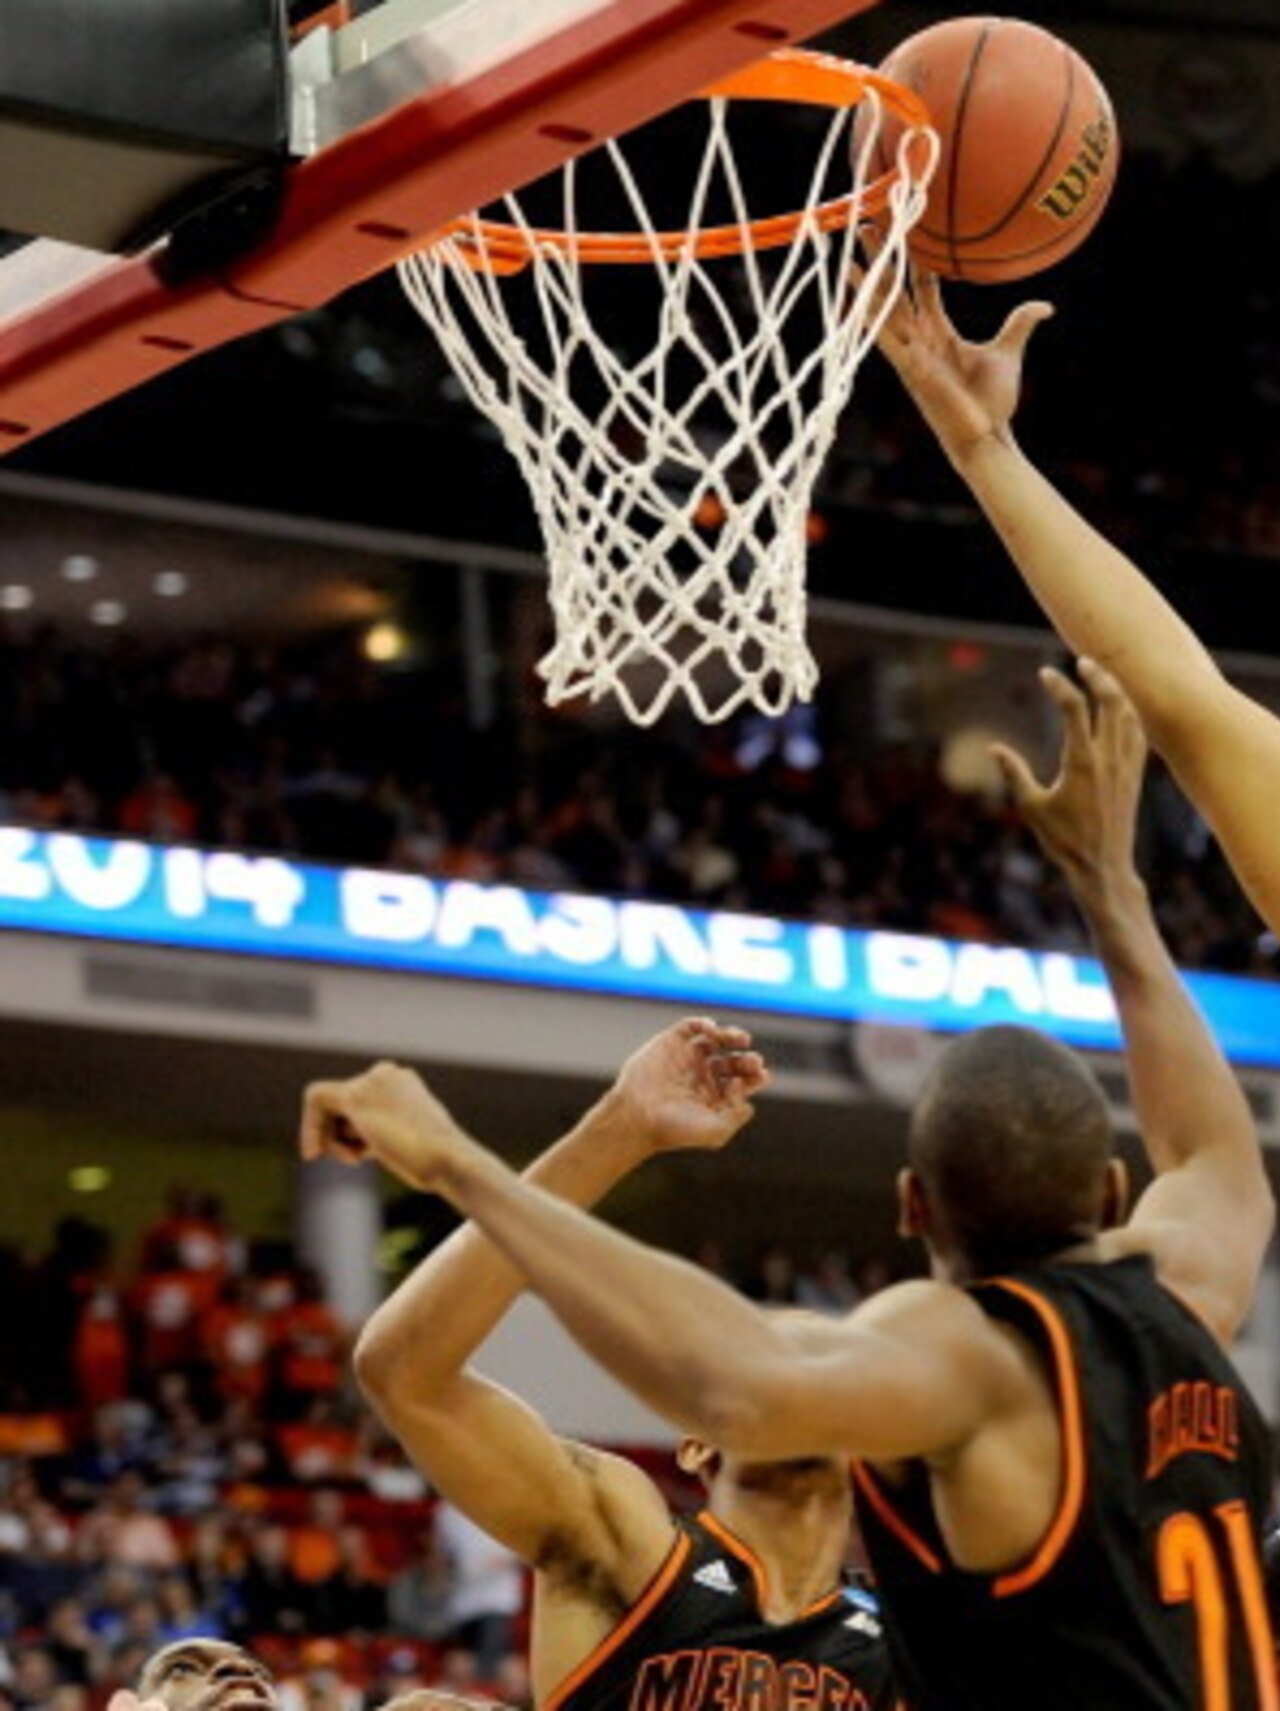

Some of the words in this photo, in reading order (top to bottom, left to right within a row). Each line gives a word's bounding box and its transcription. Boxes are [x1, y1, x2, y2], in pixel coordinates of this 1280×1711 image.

[0, 826, 305, 928] 2014
[340, 867, 1118, 1022] BASKETBAL
[630, 1645, 870, 1711] MERCE
